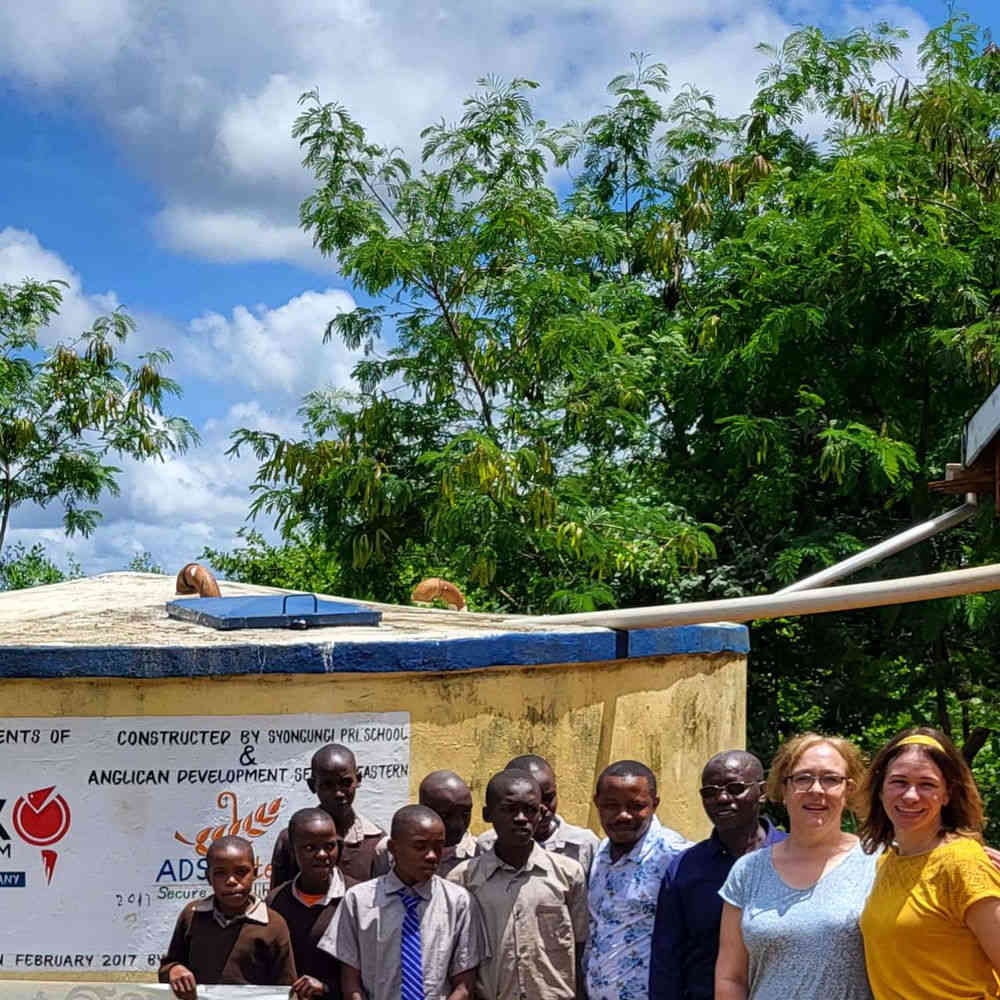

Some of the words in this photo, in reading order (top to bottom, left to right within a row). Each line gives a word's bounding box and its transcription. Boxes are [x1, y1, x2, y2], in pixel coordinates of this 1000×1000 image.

[50, 729, 71, 743] OF
[117, 730, 231, 746] CONSTRUCTED
[240, 729, 260, 744] BY
[364, 727, 408, 742] SCHOOL
[239, 745, 257, 766] &
[88, 769, 170, 785] ANGLICAN
[177, 768, 288, 784] DEVELOPMENT
[15, 954, 94, 967] FEBRUARY
[102, 954, 137, 967] 2017
